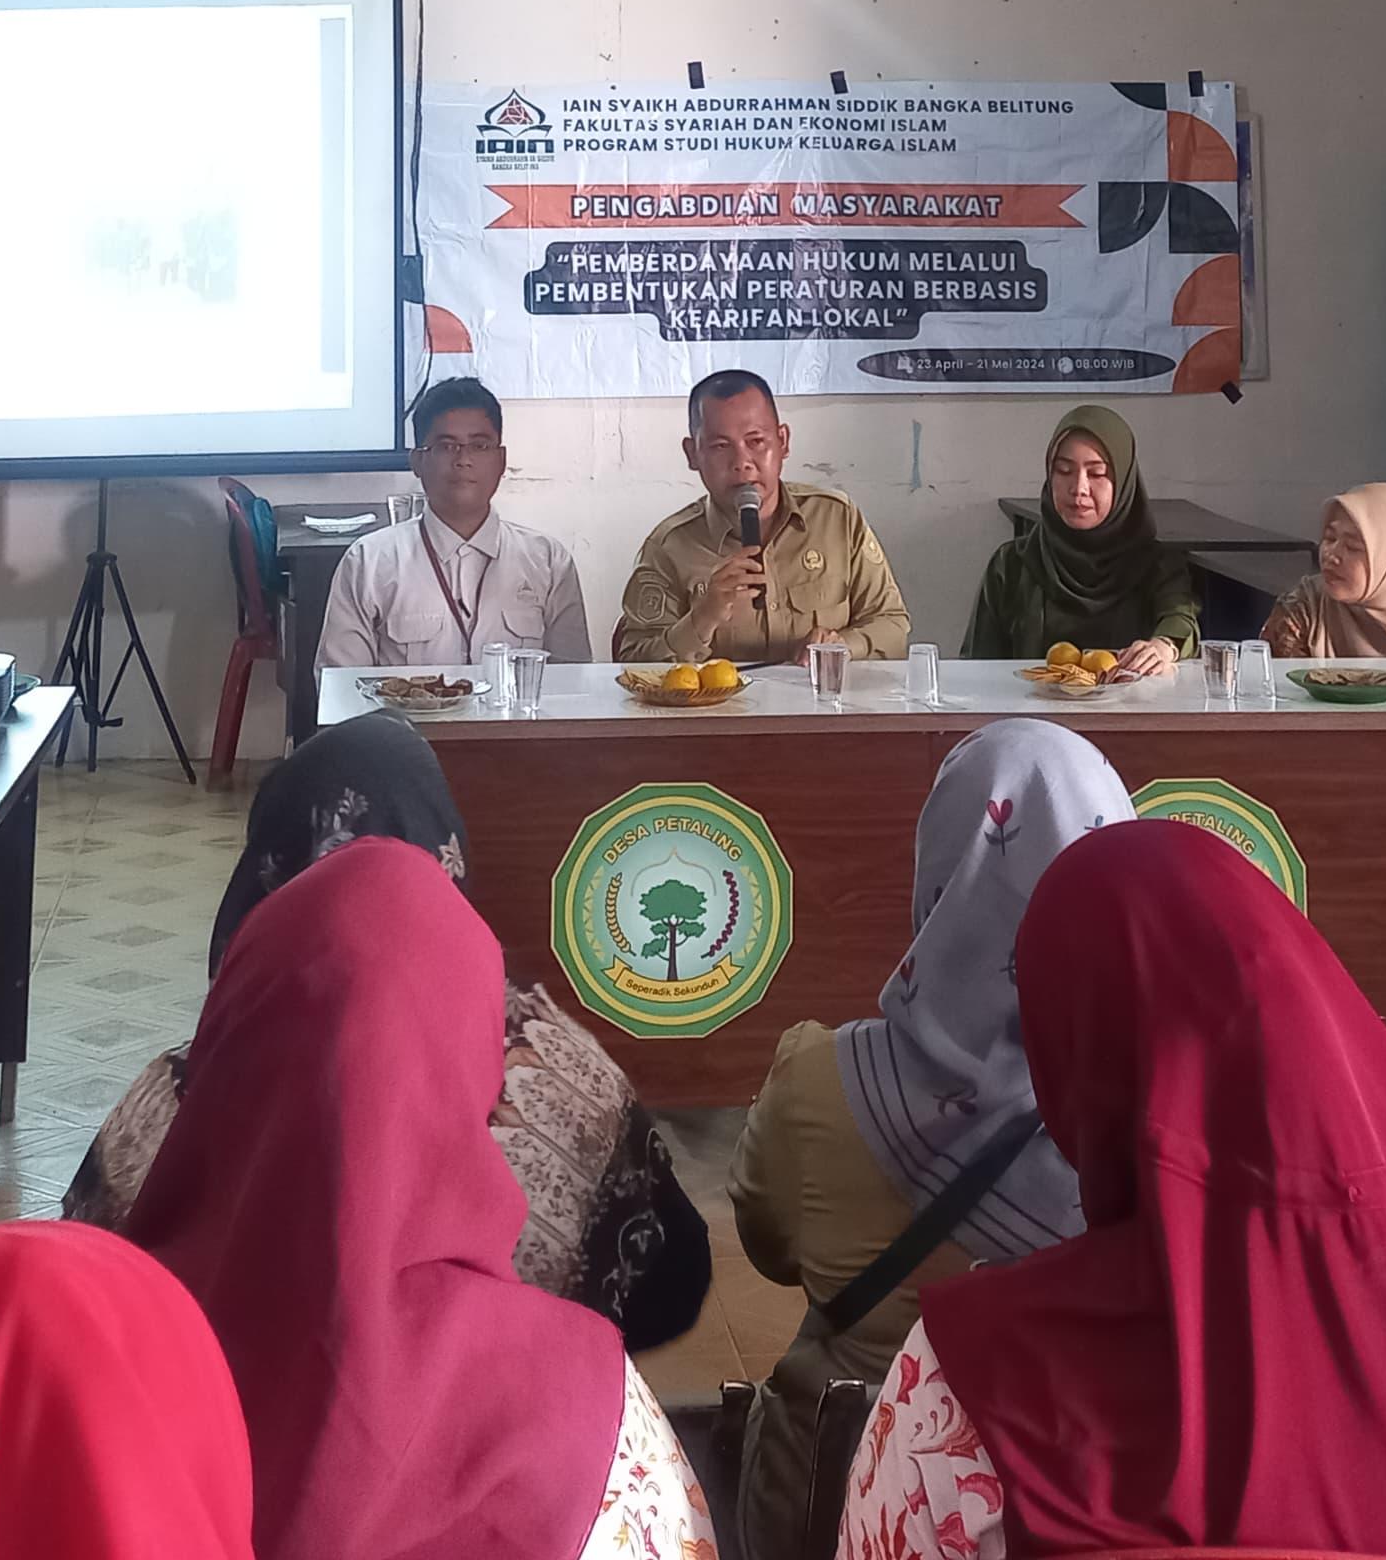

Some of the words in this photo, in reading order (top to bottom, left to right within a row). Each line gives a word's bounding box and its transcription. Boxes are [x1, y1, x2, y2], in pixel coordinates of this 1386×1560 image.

[563, 98, 602, 113] IAIN
[608, 98, 677, 113] SYAIKH
[684, 97, 831, 113] ABDURRAHMAN
[836, 99, 898, 113] SIDDIK
[904, 99, 982, 113] BANGKA
[988, 100, 1074, 114] BELITUNG
[563, 118, 658, 132] FAKULTAS
[664, 117, 747, 132] SYARIAH
[753, 116, 793, 130] DAN
[799, 117, 885, 132] EKONOMI
[891, 119, 947, 132] ISLAM
[563, 137, 657, 152] PROGRAM
[664, 137, 718, 151] STUDI
[725, 137, 793, 151] HUKUM
[799, 136, 894, 152] KELUARGA
[901, 138, 957, 152] ISLAM
[571, 194, 781, 219] PENGABDIAN
[792, 193, 1003, 218] MASYARAKAT
[803, 252, 900, 271] HUKUM
[909, 252, 1016, 272] MELALUI
[535, 281, 737, 303] PEMBENTUKAN
[747, 280, 904, 300] PERATURAN
[913, 280, 1037, 300] BERBASIS
[670, 309, 803, 329] KEARIFAN
[916, 358, 932, 370] 23
[934, 357, 963, 372] April
[977, 358, 988, 370] 21
[1015, 358, 1045, 370] 2024
[1112, 358, 1136, 370] WIB
[603, 824, 650, 865] DESA
[653, 815, 743, 861] PETALING
[624, 978, 673, 997] Seperadik
